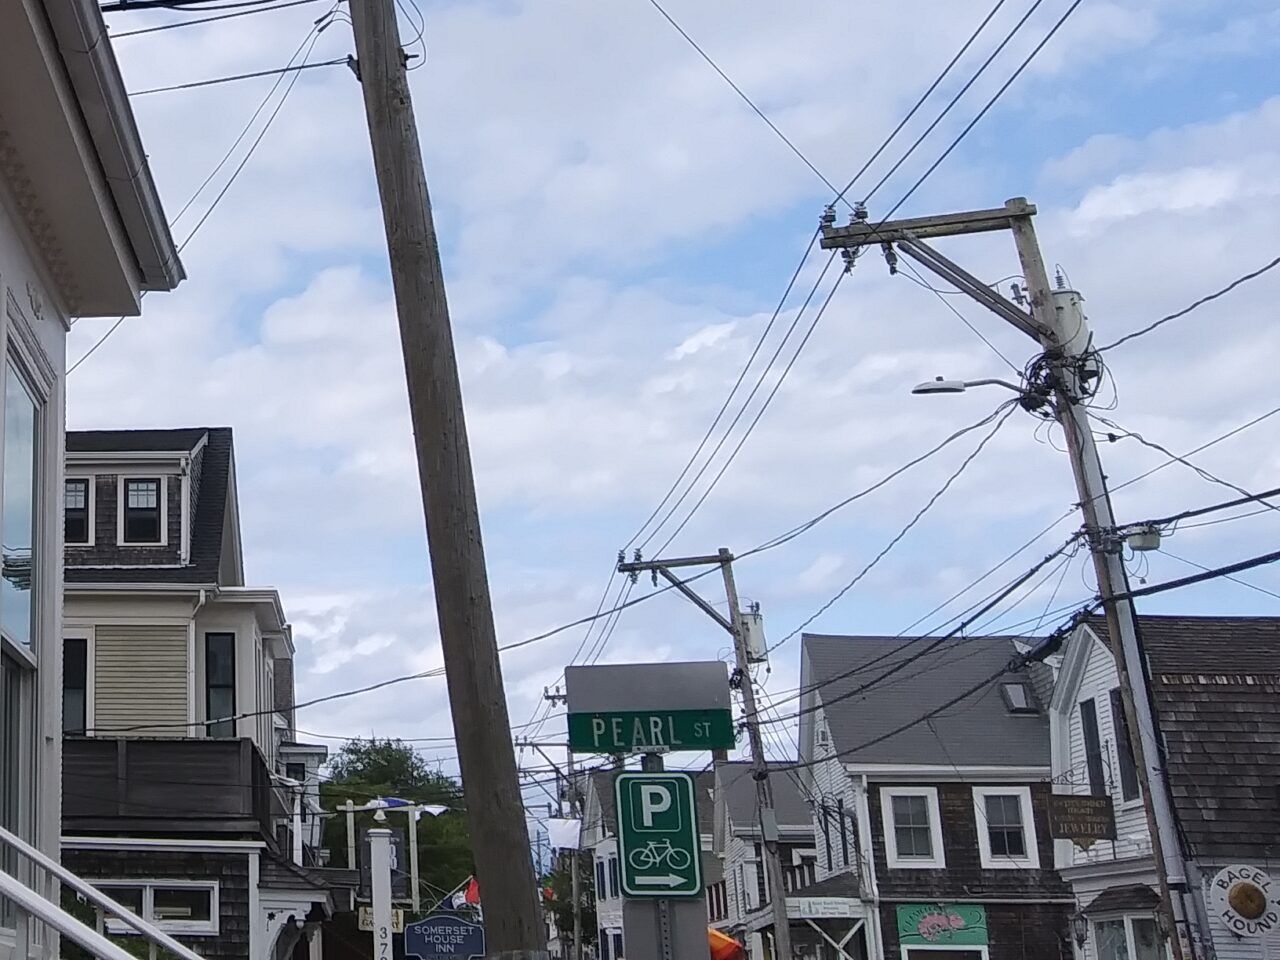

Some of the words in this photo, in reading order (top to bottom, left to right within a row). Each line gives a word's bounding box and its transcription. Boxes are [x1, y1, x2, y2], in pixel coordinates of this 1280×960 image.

[592, 717, 682, 746] PEARL
[694, 722, 711, 738] ST
[640, 784, 672, 827] P
[1216, 868, 1271, 894] BAGEL
[414, 926, 475, 935] SOMERSET
[1222, 909, 1278, 934] HOUND
[424, 935, 465, 944] HOUSE
[435, 944, 455, 953] INN
